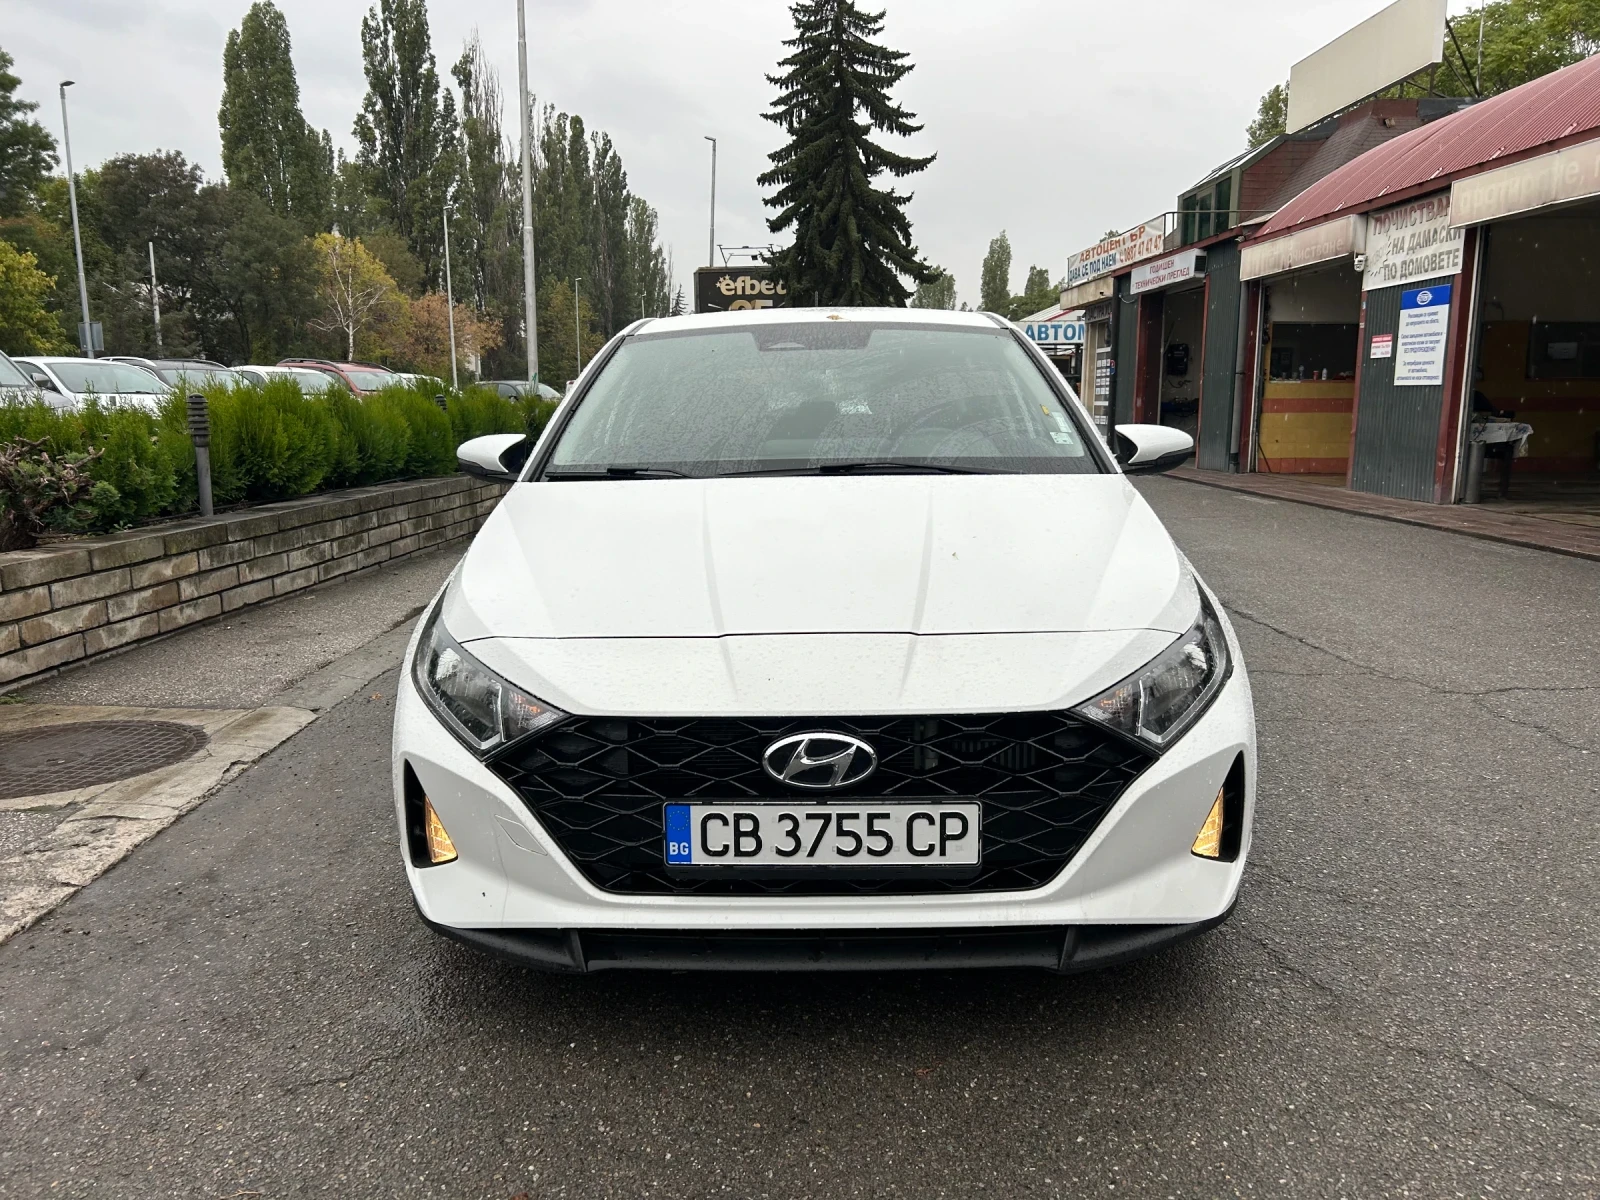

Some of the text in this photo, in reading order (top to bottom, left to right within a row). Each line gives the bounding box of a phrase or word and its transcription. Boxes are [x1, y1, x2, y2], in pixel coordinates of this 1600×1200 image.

[1391, 236, 1406, 255] НА
[1406, 225, 1461, 255] ДАМАСКИ
[1082, 263, 1089, 277] СЕ
[1090, 258, 1101, 274] ПОД
[1101, 252, 1117, 270] НАЕМ
[1149, 259, 1175, 275] ГОДИШЕН
[1383, 261, 1397, 281] ПО
[1399, 247, 1460, 281] ДОМОВЕТЕ
[720, 275, 787, 296] efbet
[1135, 266, 1190, 290] ТЕХНИЧЕСКИ ПРЕГЛЕД
[700, 811, 969, 858] CB 3755 CP
[669, 842, 689, 855] BG
